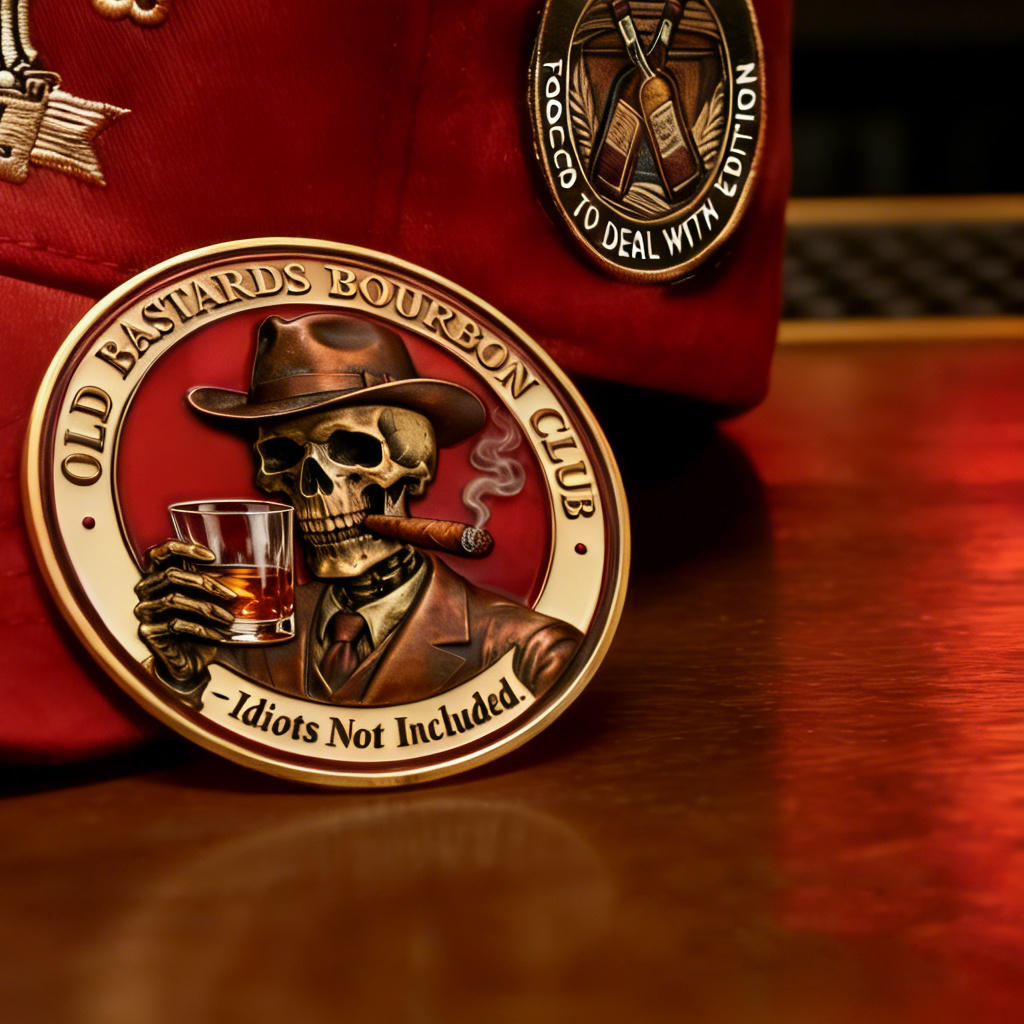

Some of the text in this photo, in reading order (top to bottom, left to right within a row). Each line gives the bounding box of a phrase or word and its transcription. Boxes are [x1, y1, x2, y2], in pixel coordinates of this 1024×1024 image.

[573, 192, 601, 231] TO
[602, 220, 660, 261] DEAL
[61, 262, 596, 520] OLD BASTARDS BOURBON CLUB
[329, 717, 385, 750] Not
[394, 677, 528, 748] Included.
